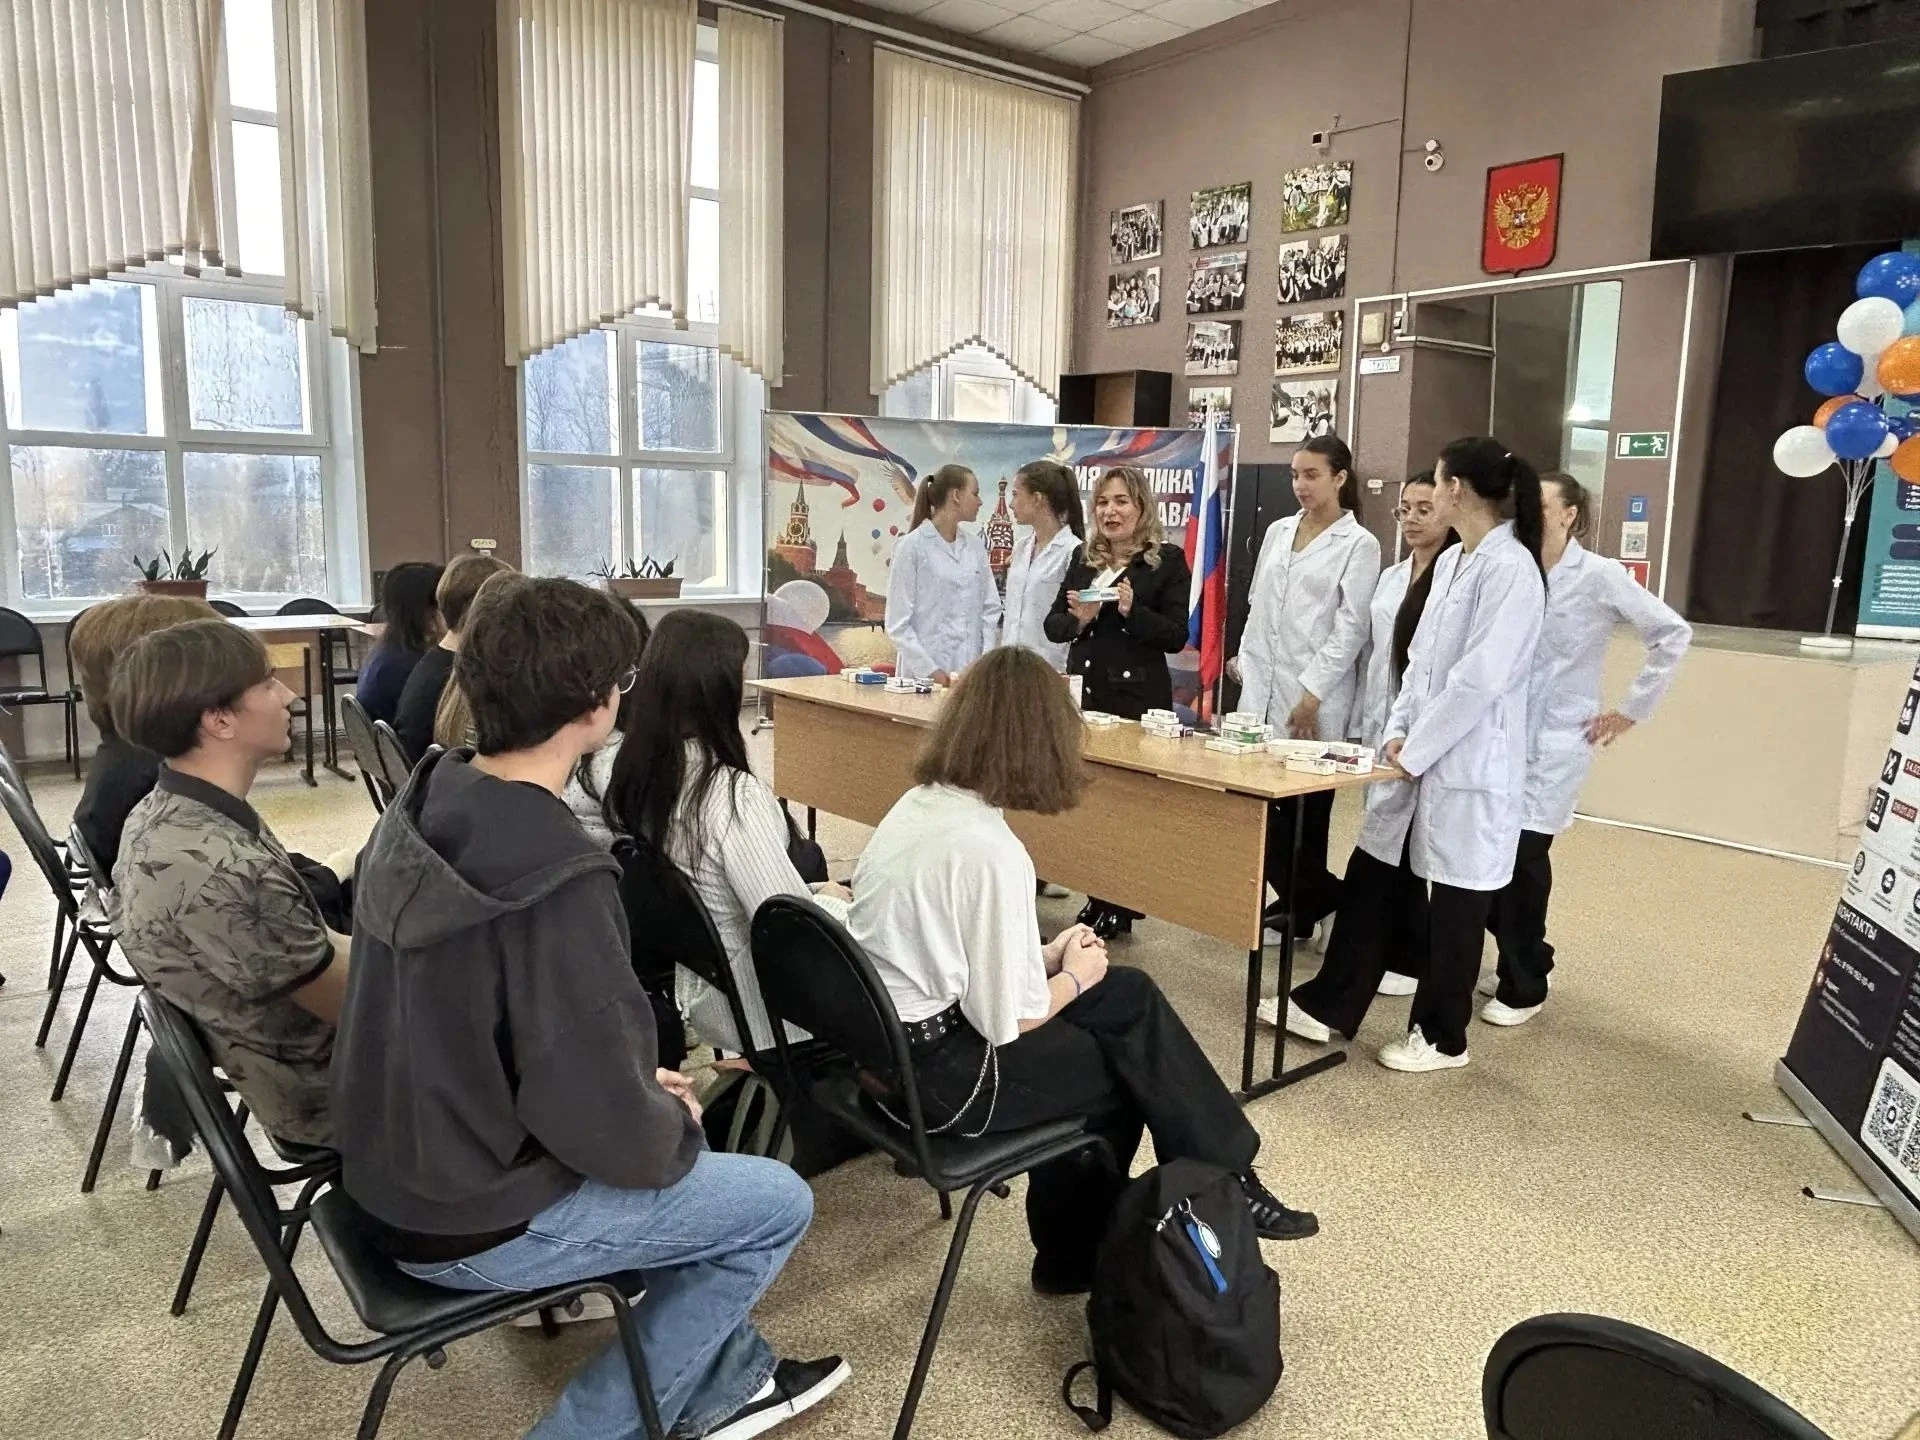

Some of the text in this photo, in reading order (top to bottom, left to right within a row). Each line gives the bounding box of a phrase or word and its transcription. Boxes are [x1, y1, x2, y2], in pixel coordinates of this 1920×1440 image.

[1067, 465, 1198, 494] ИЯ ЛИКА
[1158, 501, 1192, 527] АВА
